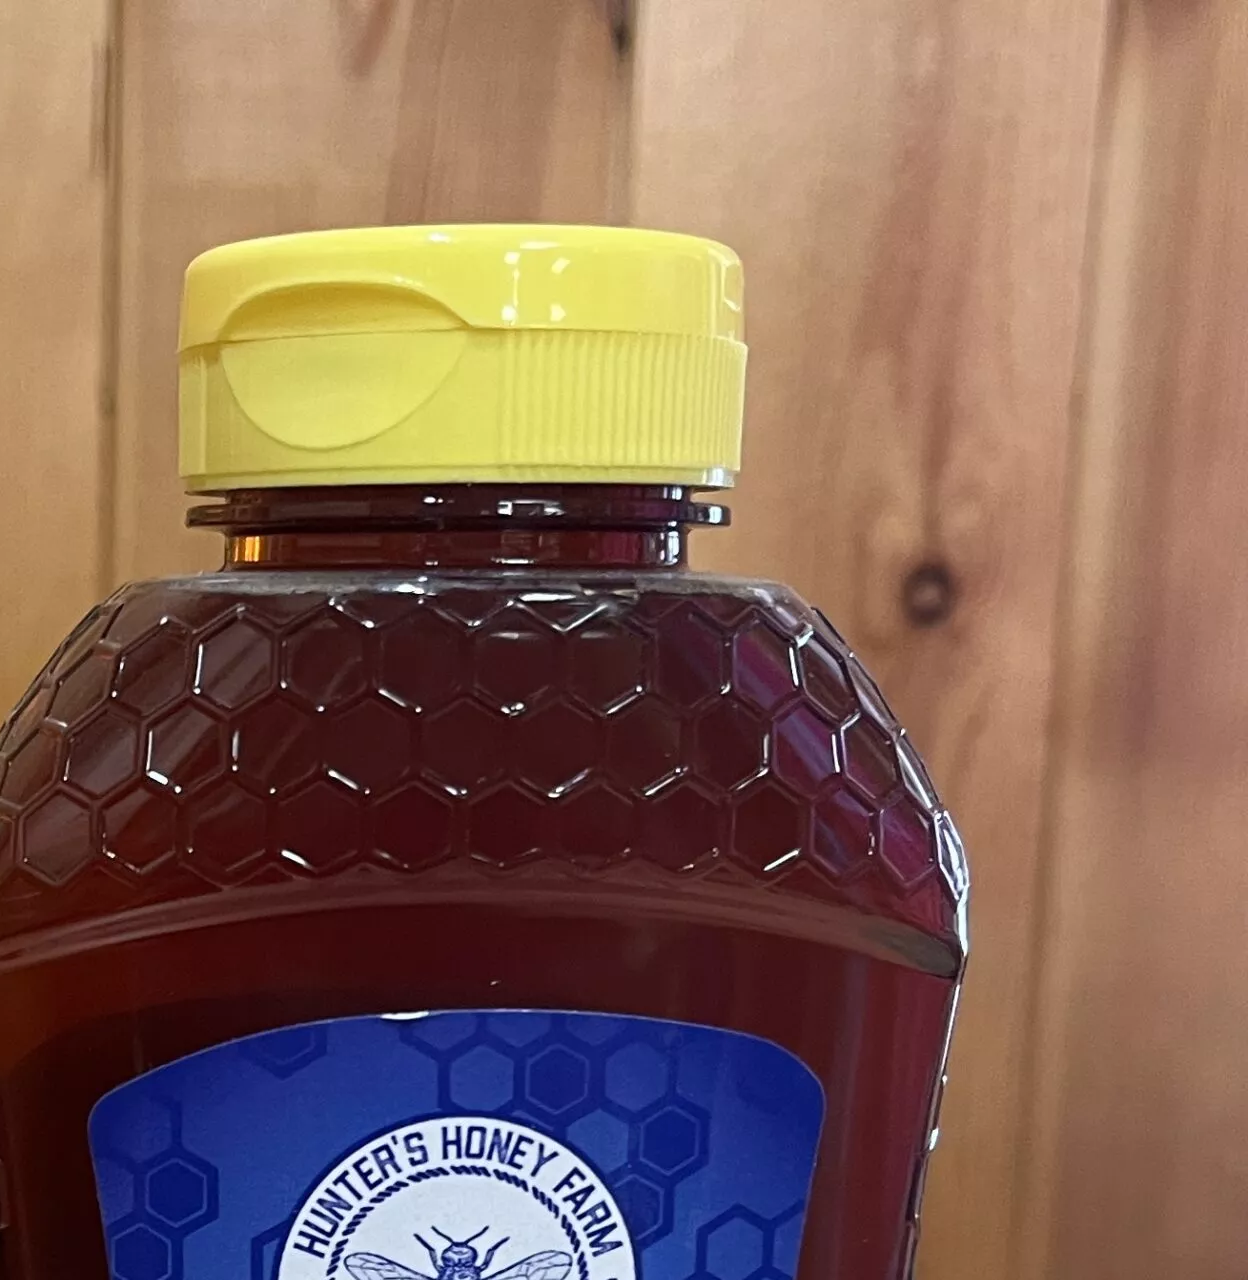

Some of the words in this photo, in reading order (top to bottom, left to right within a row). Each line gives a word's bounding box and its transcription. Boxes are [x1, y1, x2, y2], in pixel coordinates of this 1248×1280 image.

[293, 1132, 429, 1258] HUNTER'S
[442, 1126, 559, 1176] HONEY
[553, 1167, 623, 1257] FARM
